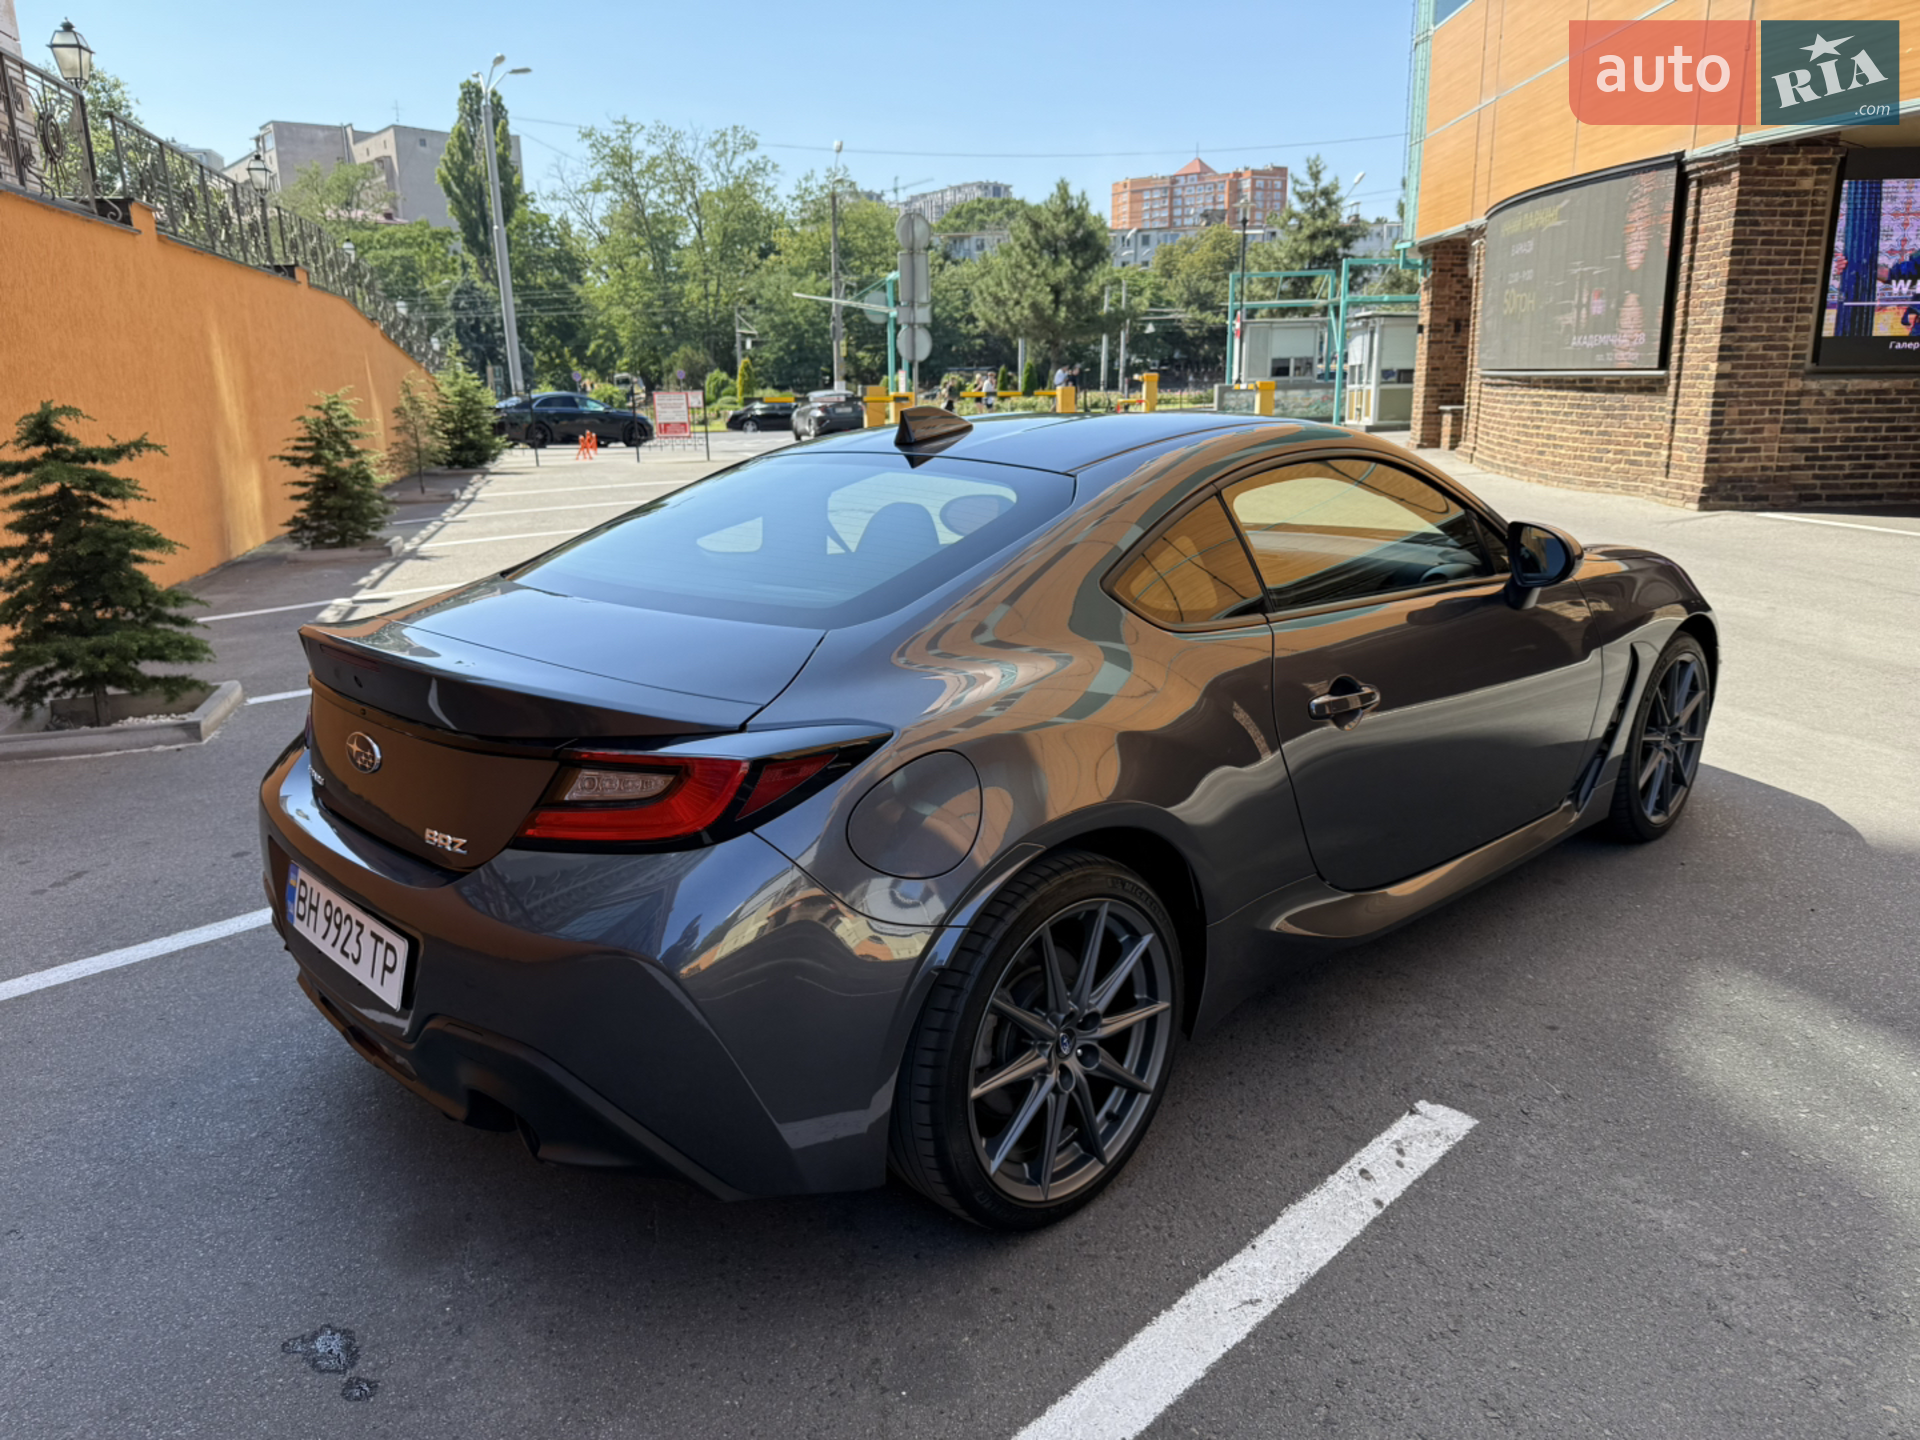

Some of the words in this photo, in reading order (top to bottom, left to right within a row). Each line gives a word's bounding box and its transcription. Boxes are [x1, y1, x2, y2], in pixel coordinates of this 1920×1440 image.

[424, 828, 467, 853] BRZ
[296, 879, 320, 934] BH
[322, 899, 363, 965] 9923
[370, 931, 398, 987] TP
